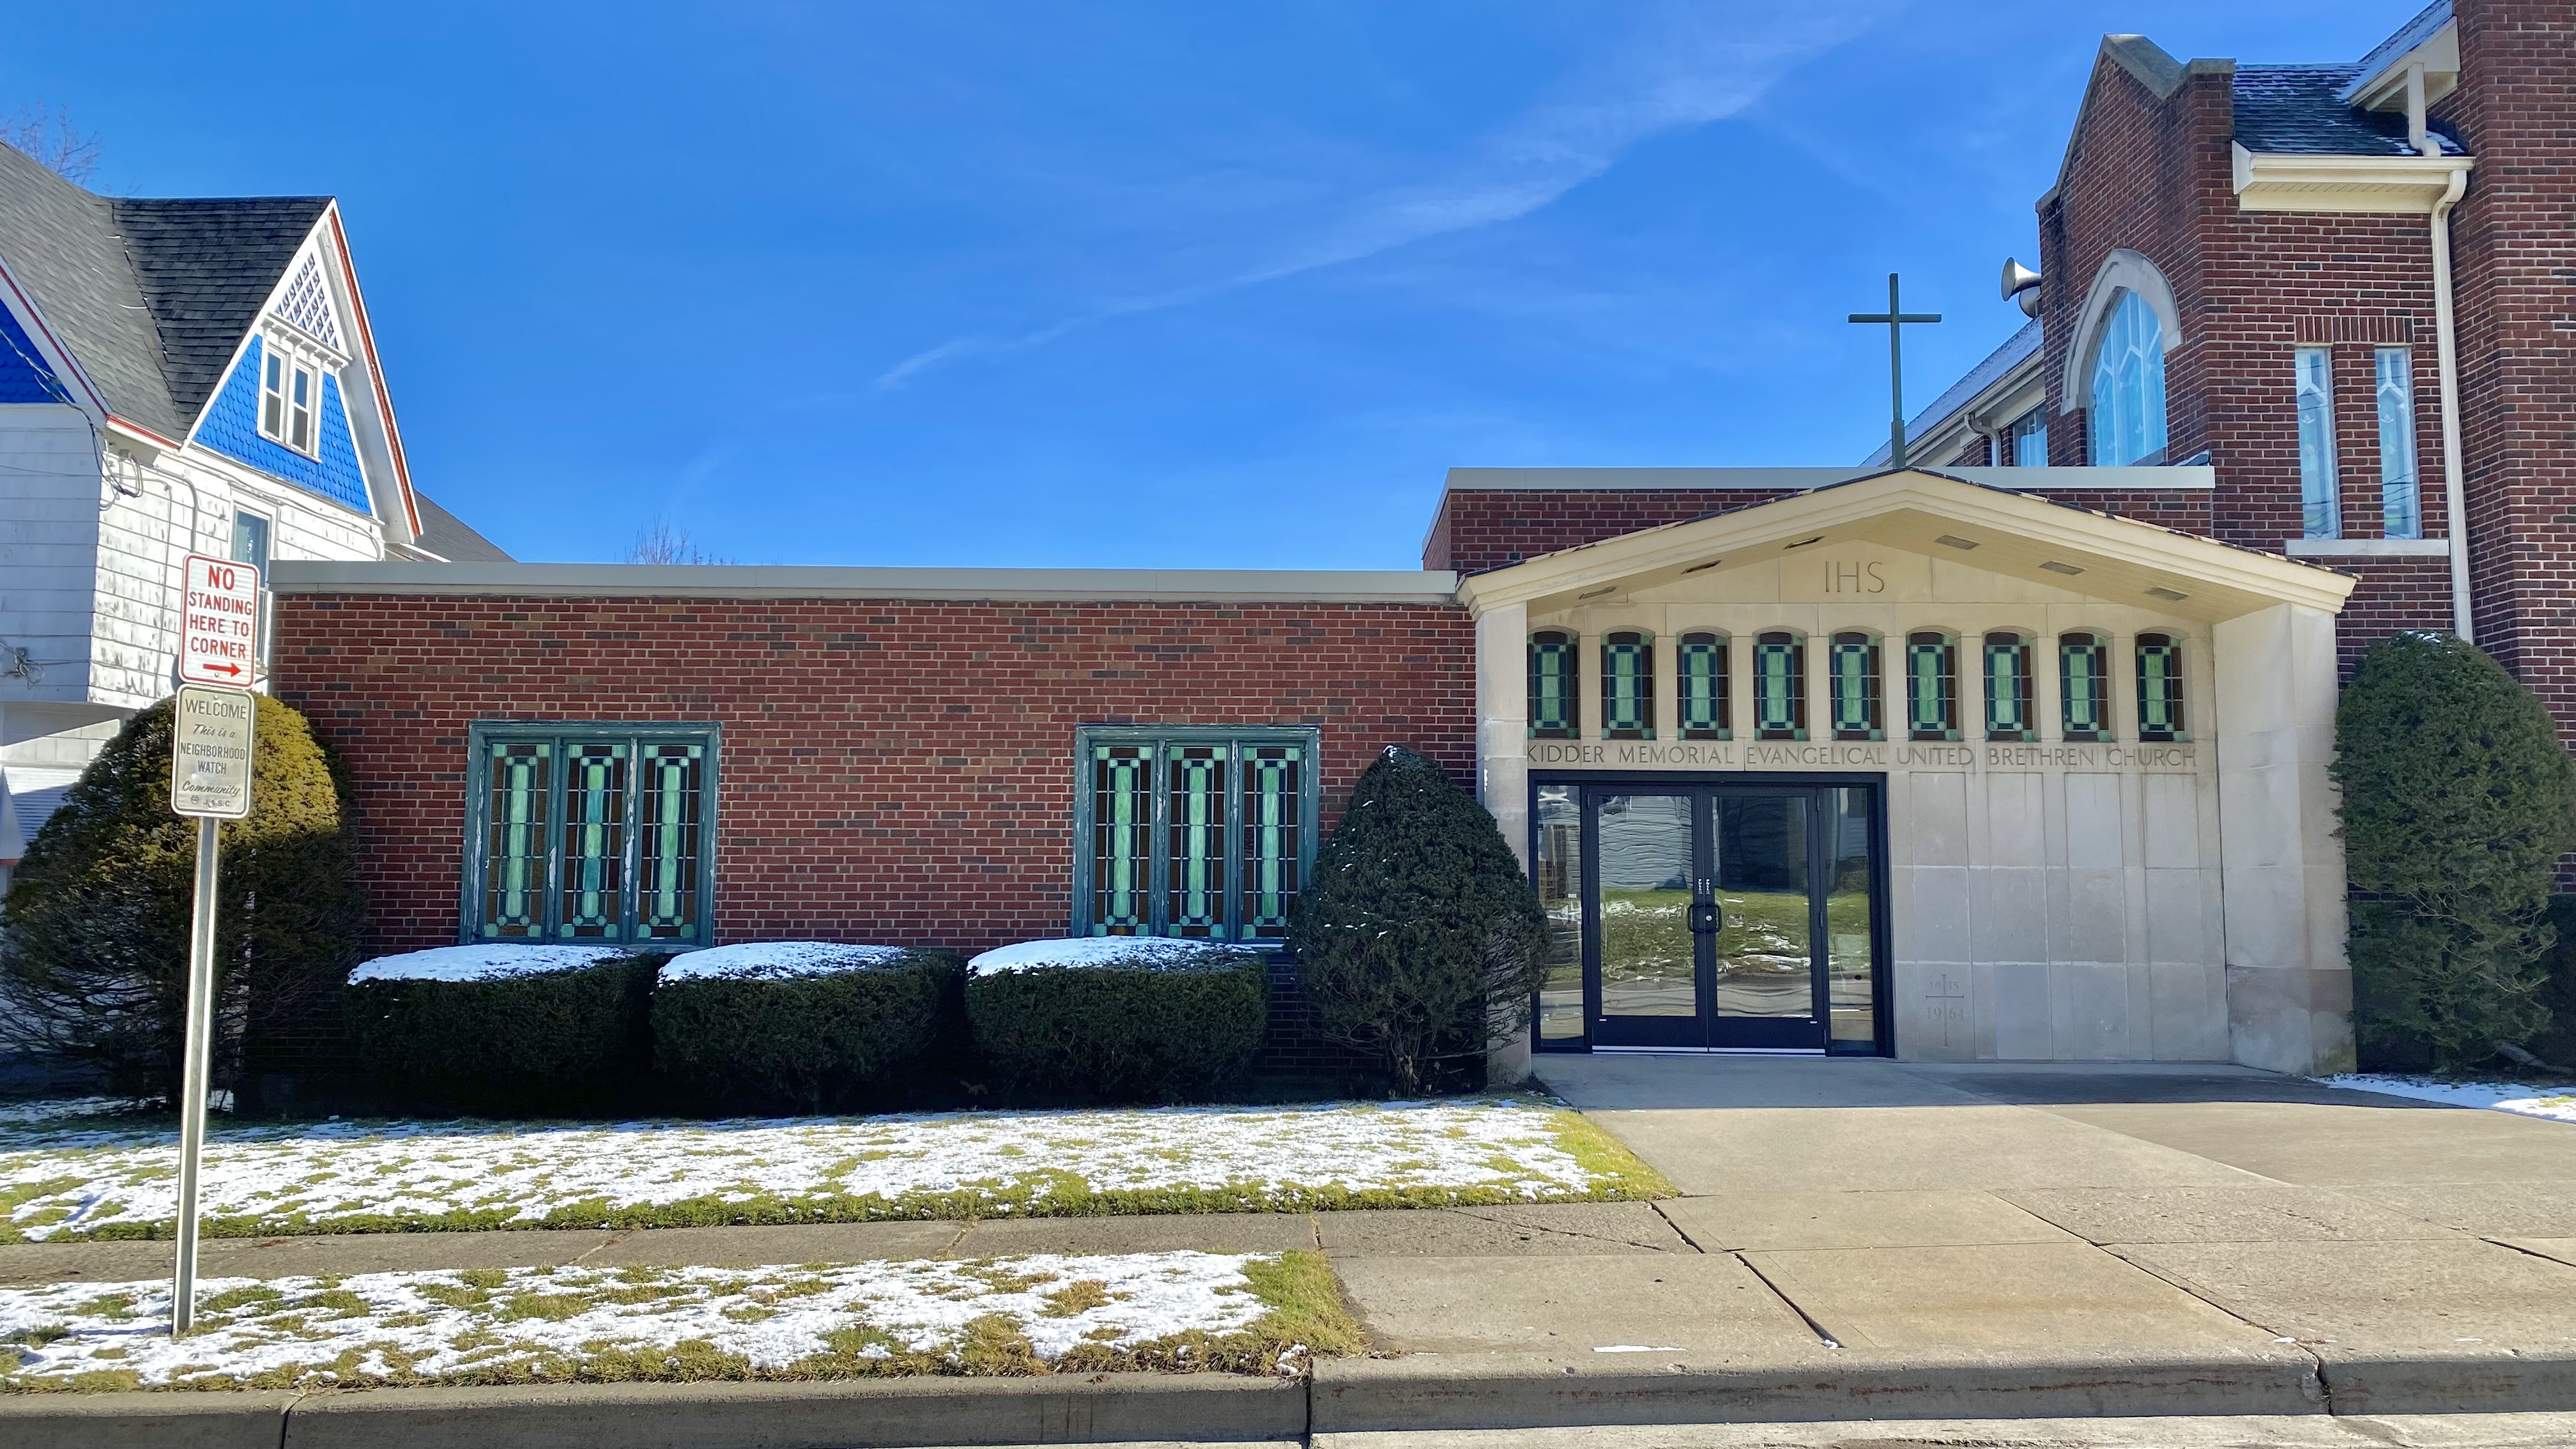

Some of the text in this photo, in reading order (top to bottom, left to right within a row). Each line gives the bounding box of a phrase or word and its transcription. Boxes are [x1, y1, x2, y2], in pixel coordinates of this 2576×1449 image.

[208, 564, 235, 591] NO
[1825, 561, 1884, 593] IHS
[188, 591, 252, 616] STANDING
[190, 613, 249, 637] HERE TO
[190, 636, 246, 659] CORNER
[185, 698, 247, 719] WELCOME
[193, 723, 216, 736] This
[218, 727, 226, 738] is
[180, 742, 245, 760] NEIGHBORHOOD
[1527, 745, 2196, 767] KIDDER MEMORIAL EVANGELICAL UNITED BRETHREN CHURCH
[197, 760, 227, 774] WATCH
[182, 780, 241, 798] Community
[203, 799, 232, 808] JA.S.C.
